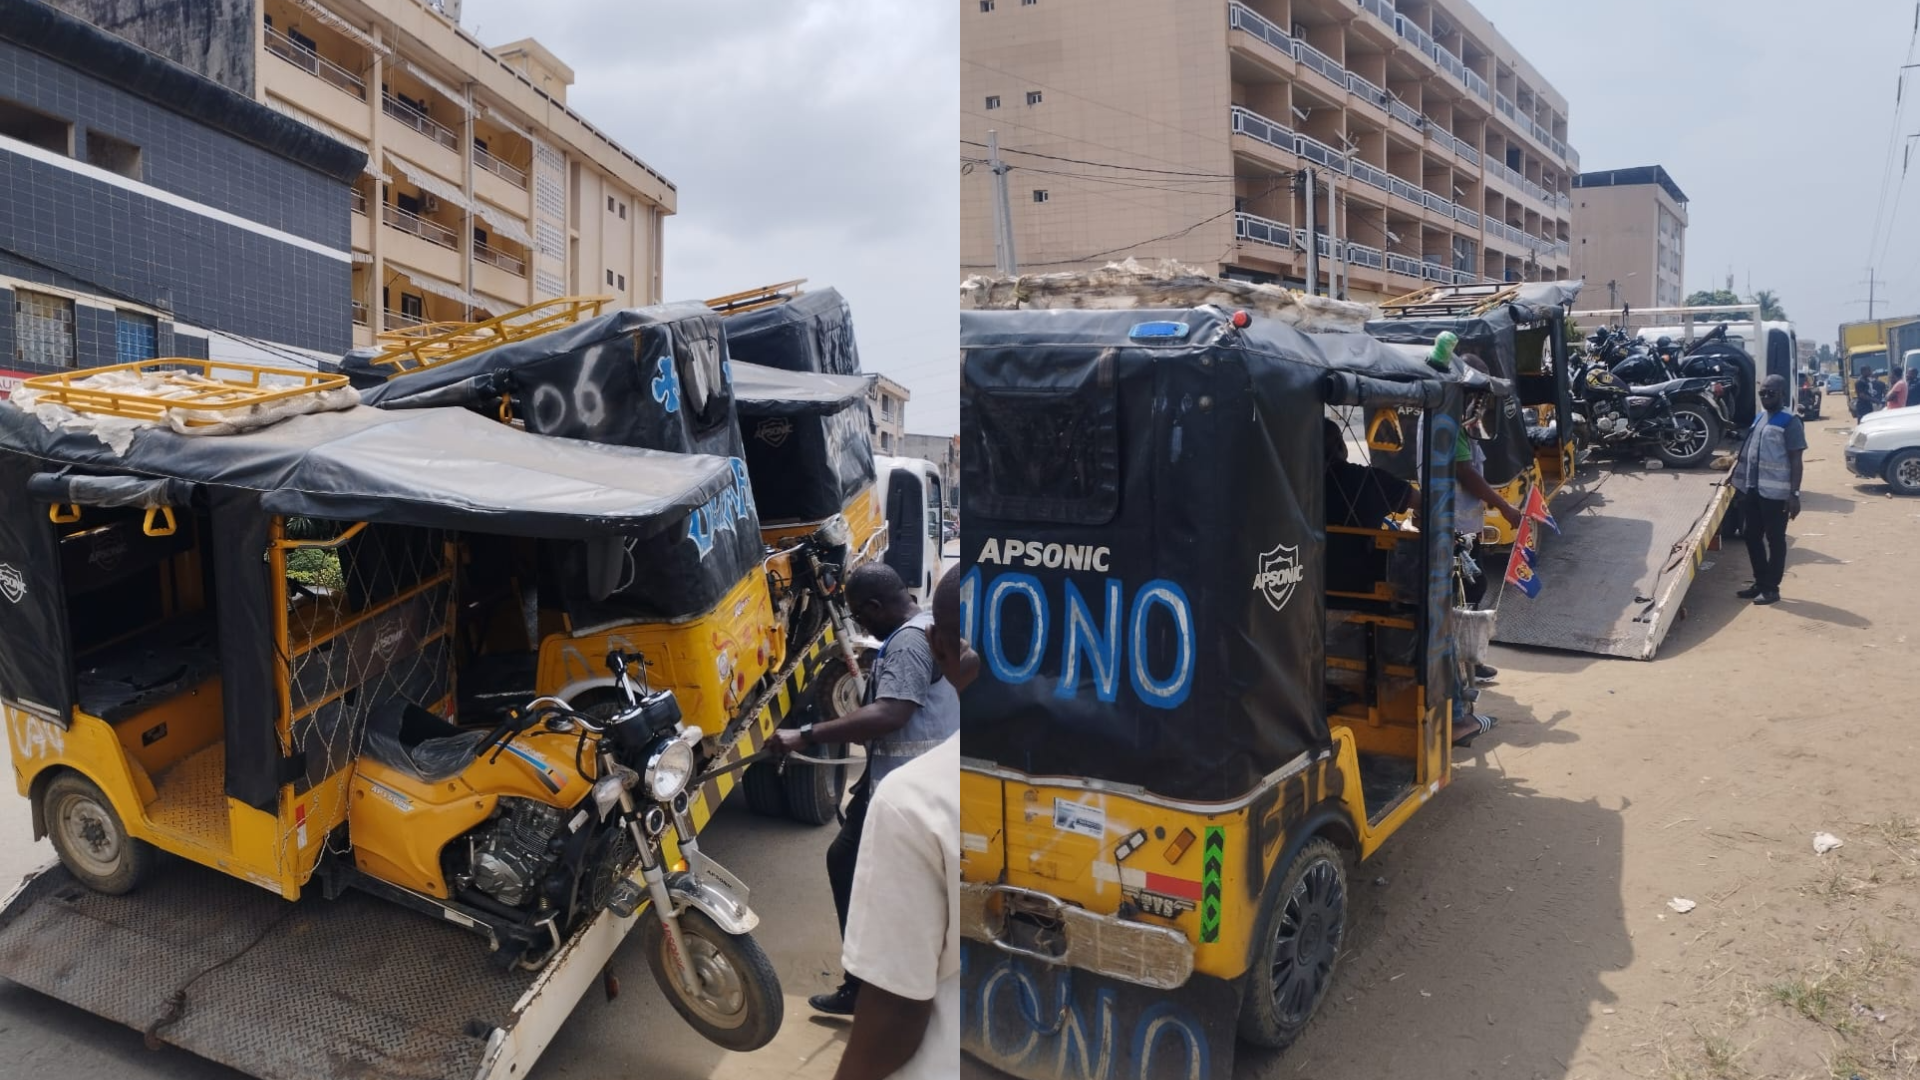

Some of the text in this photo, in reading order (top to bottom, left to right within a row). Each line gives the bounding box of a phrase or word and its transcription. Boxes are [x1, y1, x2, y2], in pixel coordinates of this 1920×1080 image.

[533, 344, 606, 434] 06
[977, 537, 1111, 572] APSONIC
[1252, 564, 1304, 590] APSONIC
[960, 955, 1210, 1080] ONO
